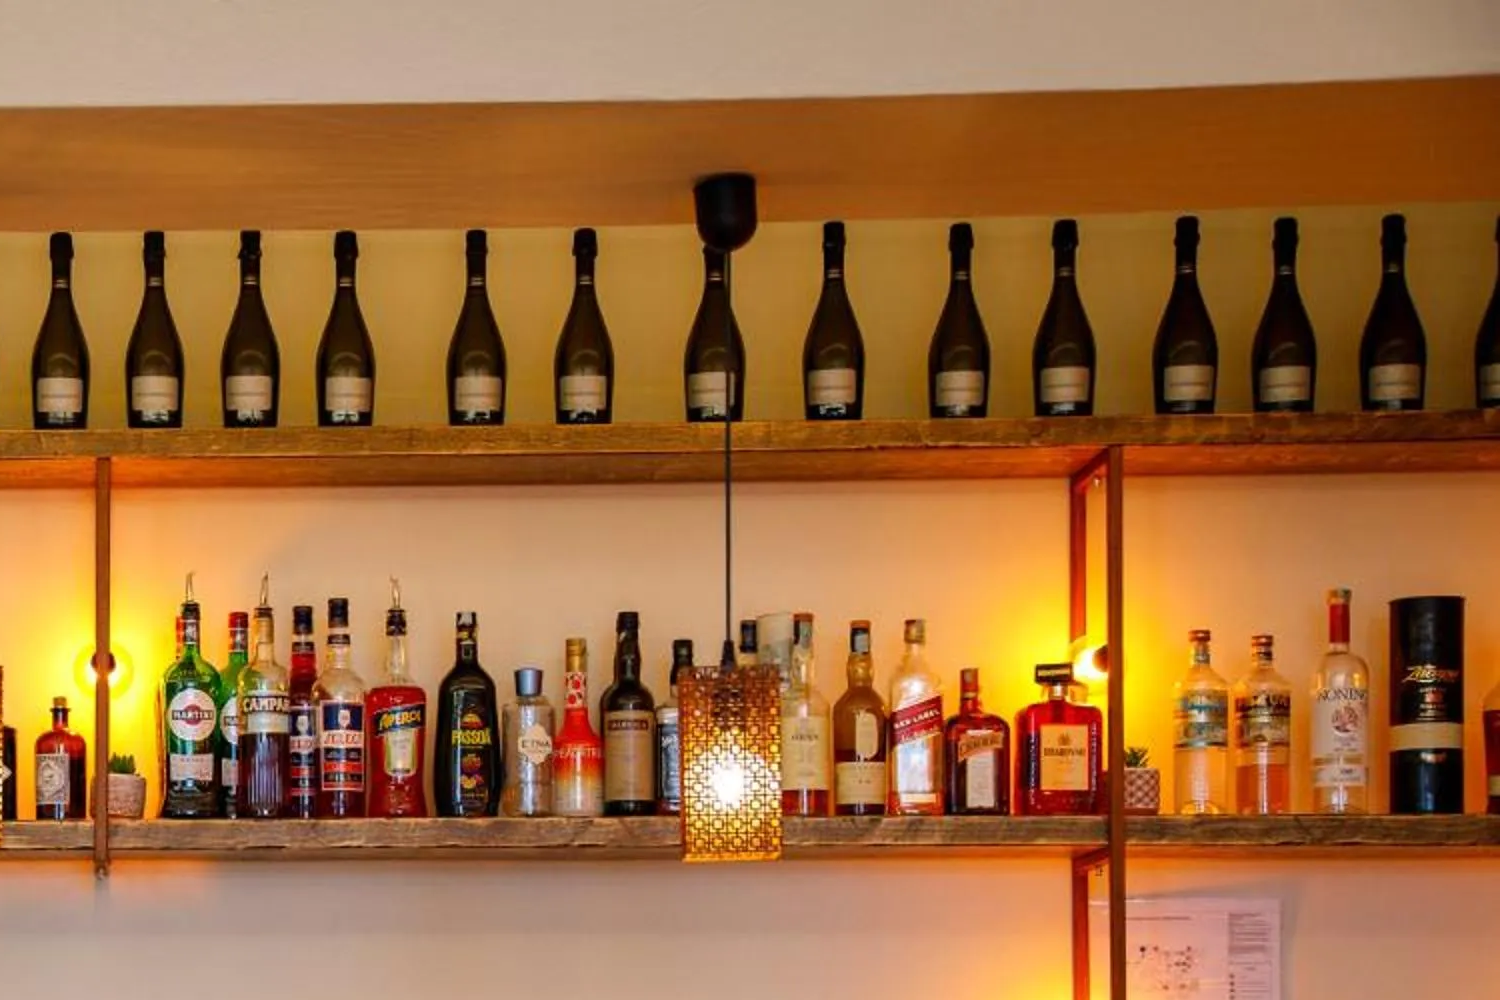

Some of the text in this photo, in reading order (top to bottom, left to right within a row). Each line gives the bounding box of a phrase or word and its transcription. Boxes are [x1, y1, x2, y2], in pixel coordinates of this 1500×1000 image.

[173, 710, 212, 720] MARTINI
[379, 709, 421, 731] APEROL
[520, 740, 550, 749] ETNA
